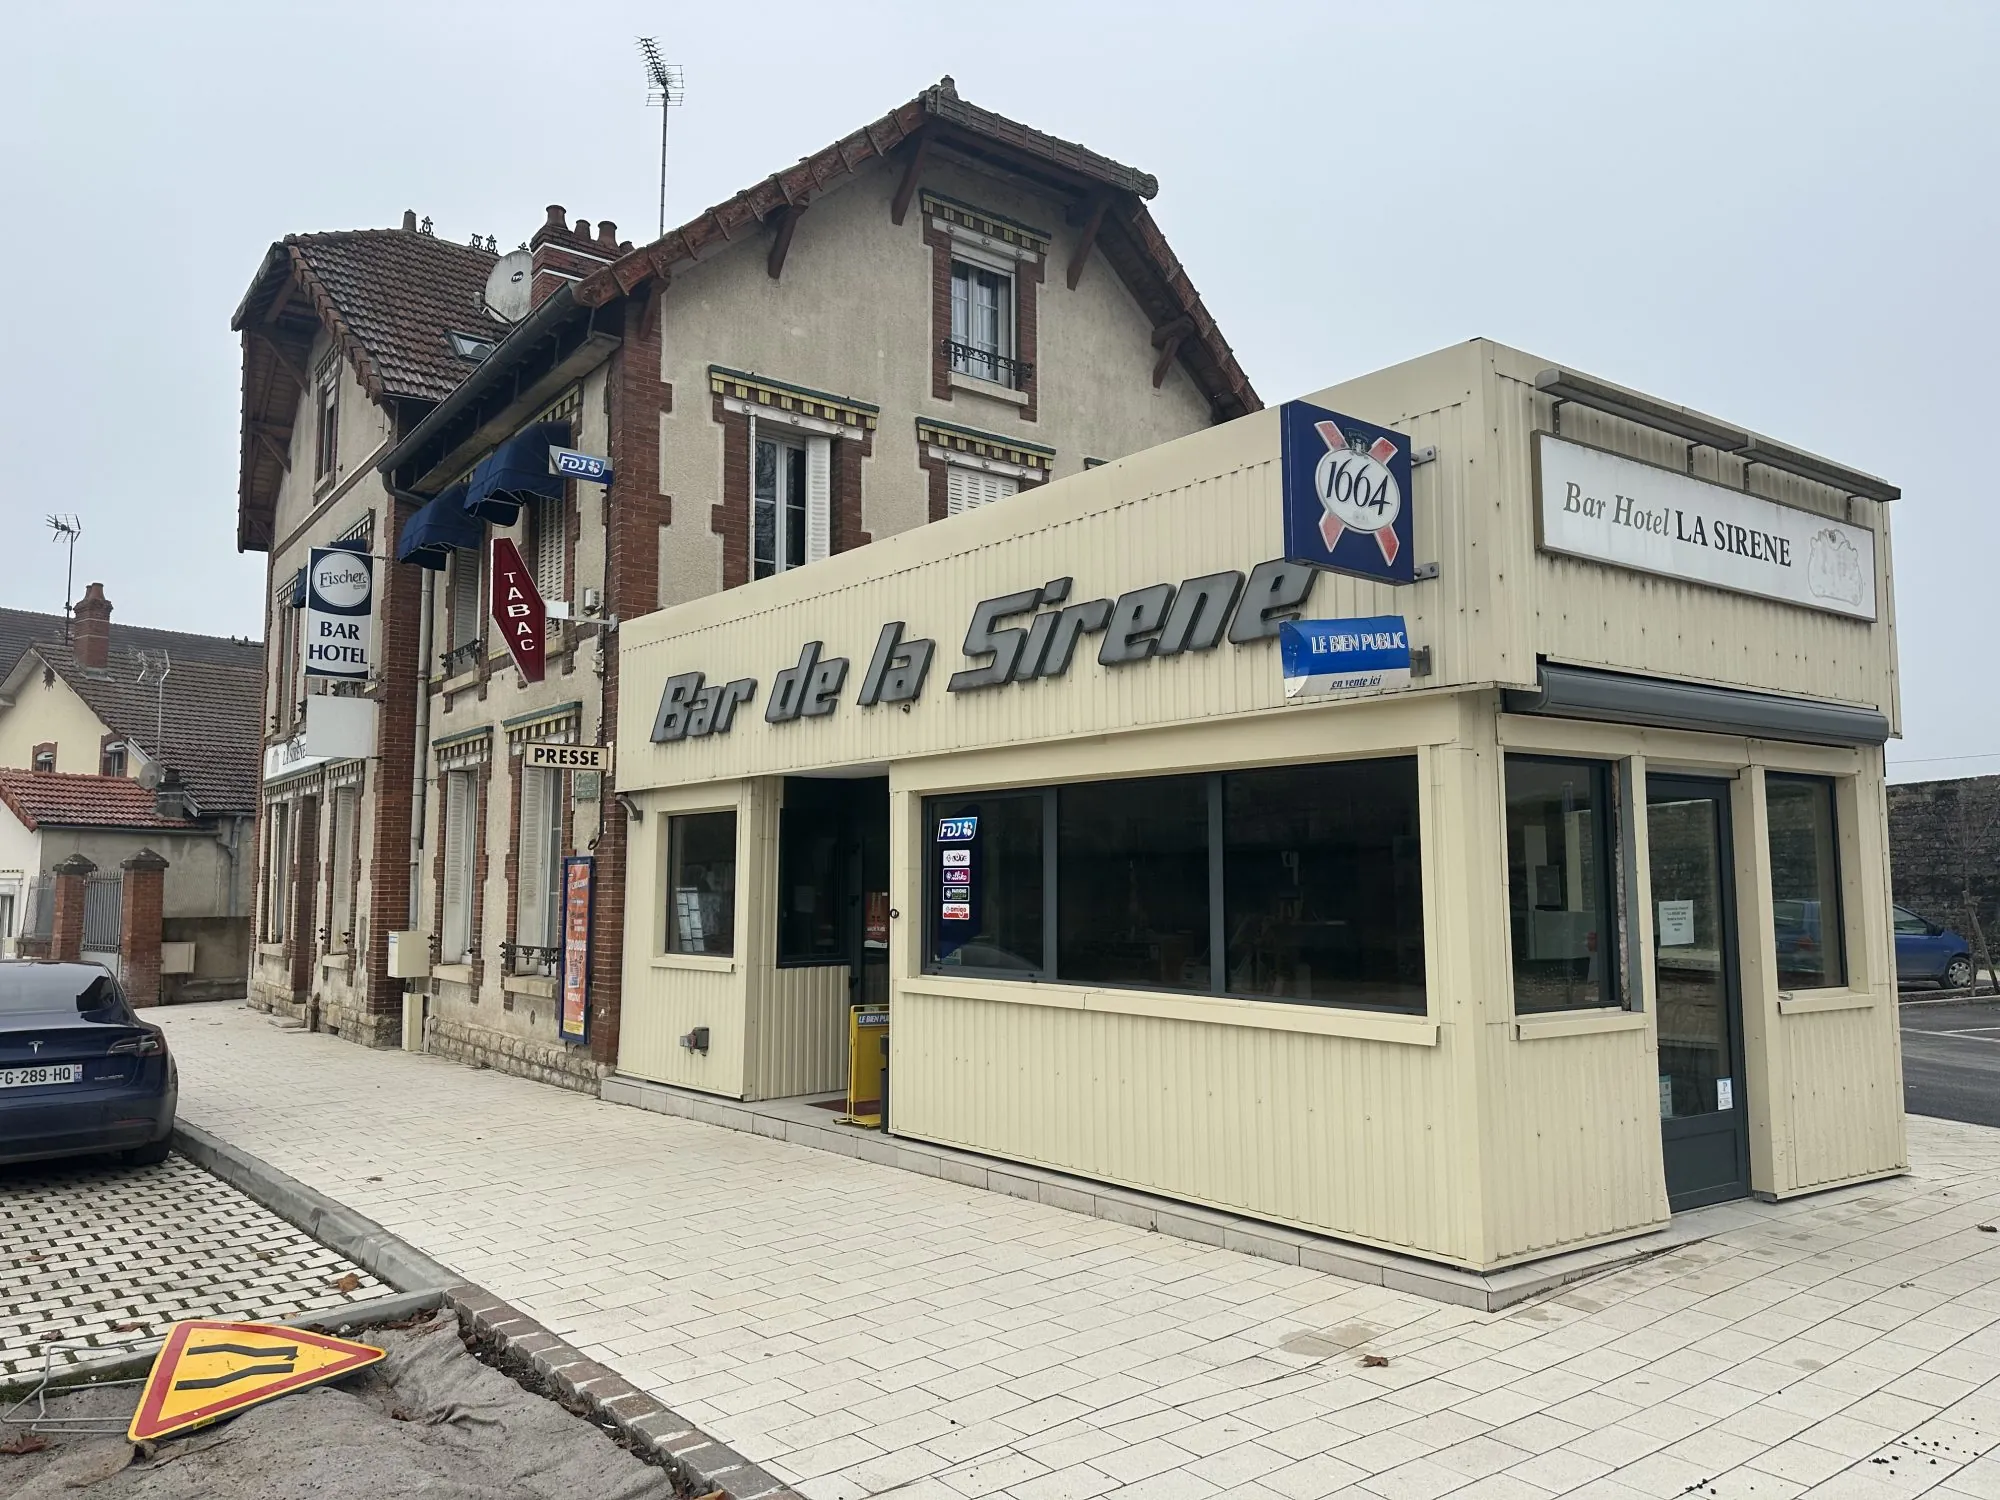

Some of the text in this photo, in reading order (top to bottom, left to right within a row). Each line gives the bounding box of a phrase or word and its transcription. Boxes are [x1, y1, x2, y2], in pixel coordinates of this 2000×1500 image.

[561, 455, 587, 471] FDJ
[1326, 458, 1392, 516] 1664
[1563, 481, 1792, 568] Bar Hotel LA SIRENE
[320, 569, 364, 587] Fischer
[503, 572, 536, 651] TABAC
[320, 621, 360, 641] BAR
[649, 558, 1317, 744] Bar de la Sirene
[1311, 631, 1406, 654] LE BIEN PUBLIC
[308, 643, 368, 665] HOTEL
[1331, 674, 1382, 688] en vente ici
[534, 747, 599, 766] PRESSE
[940, 822, 962, 838] FDJ
